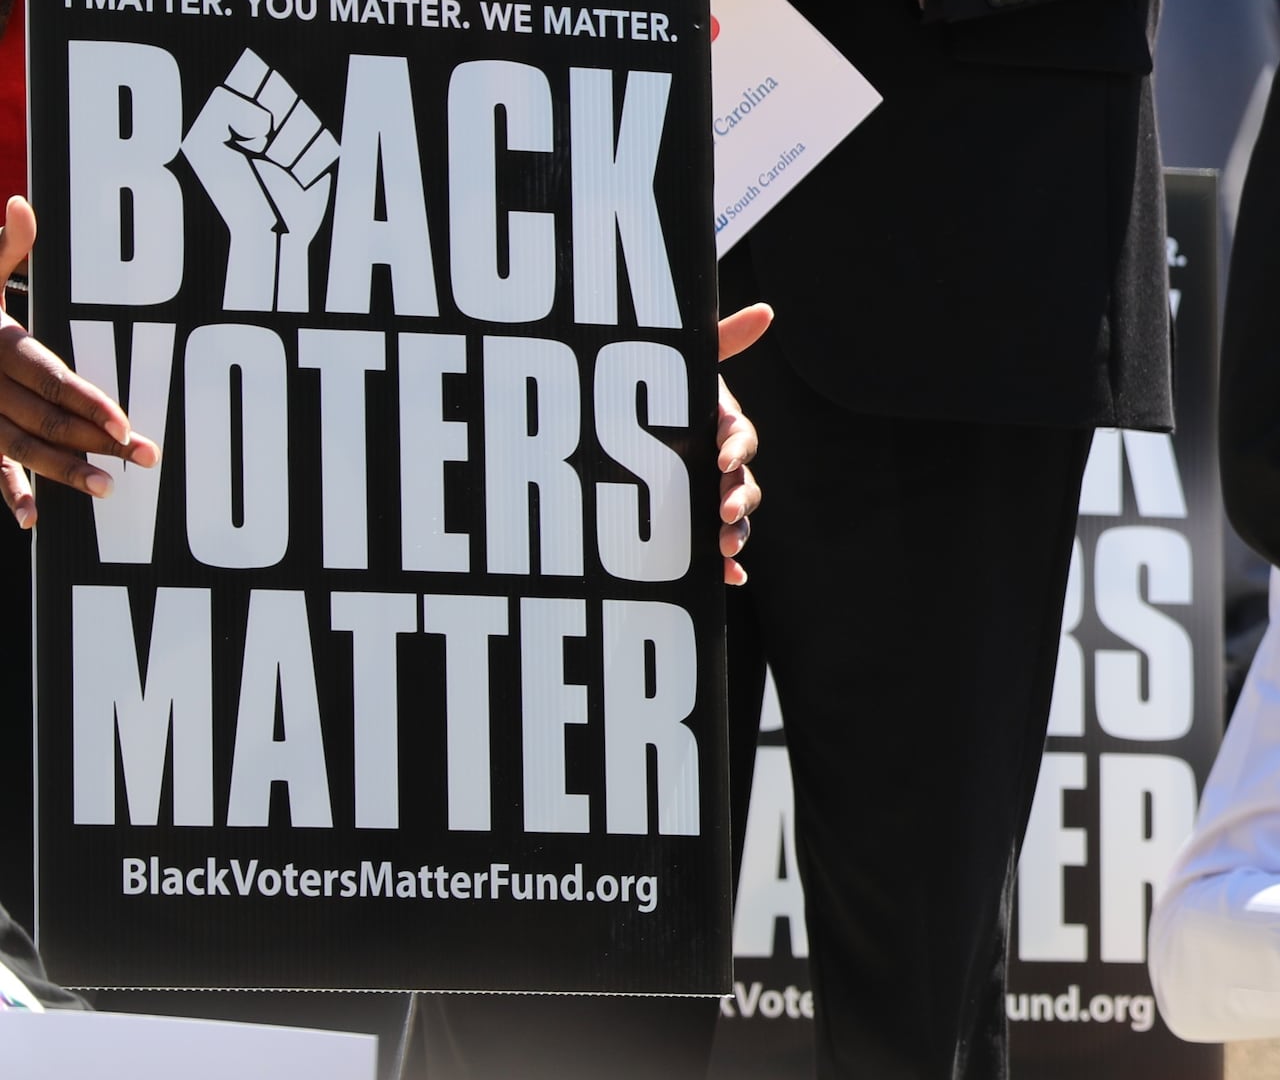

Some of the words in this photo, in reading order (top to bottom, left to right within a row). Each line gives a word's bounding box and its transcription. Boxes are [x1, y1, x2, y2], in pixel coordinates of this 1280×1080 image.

[479, 1, 533, 33] WE
[543, 6, 679, 42] MATTER.
[713, 74, 779, 138] Carolina
[726, 184, 761, 220] South
[758, 141, 806, 189] Carolina
[70, 320, 692, 582] VOTERS
[72, 584, 700, 836] MATTER
[121, 856, 660, 913] BlackVotersMatterFund.org
